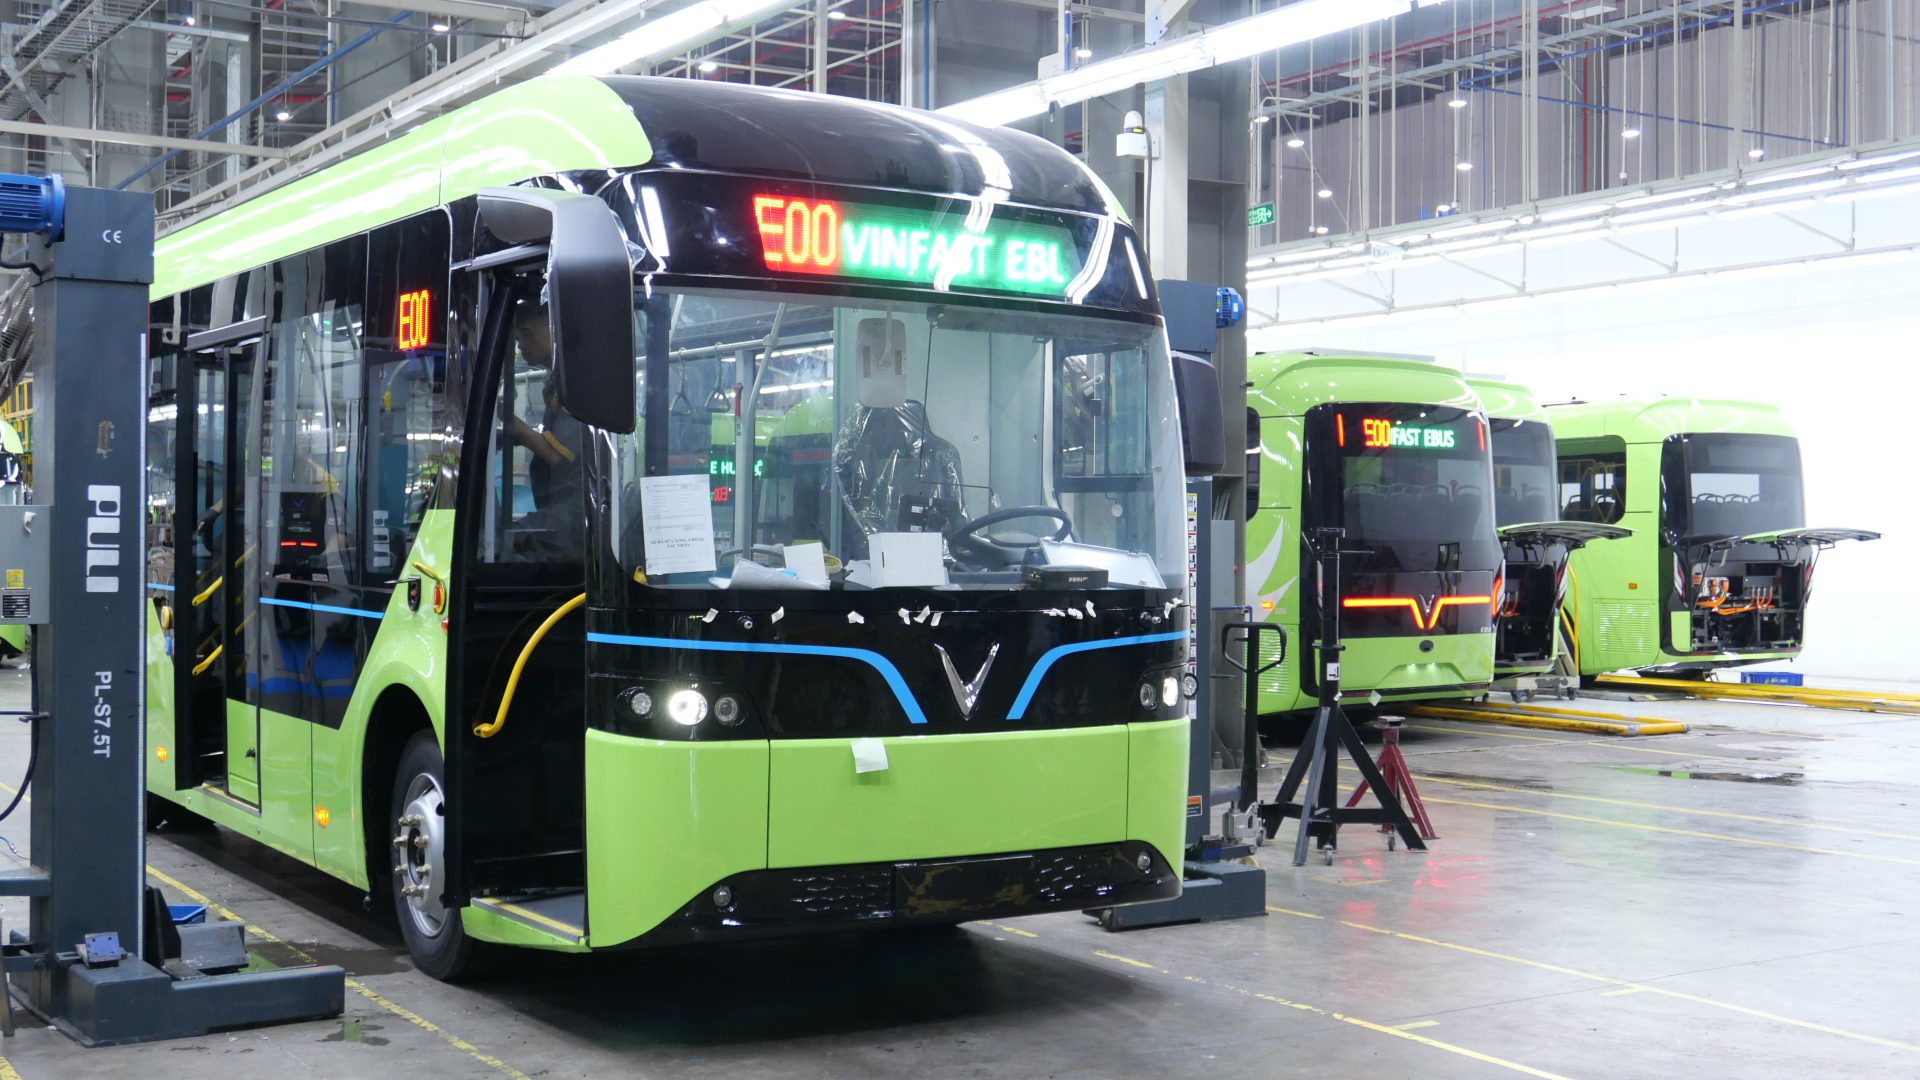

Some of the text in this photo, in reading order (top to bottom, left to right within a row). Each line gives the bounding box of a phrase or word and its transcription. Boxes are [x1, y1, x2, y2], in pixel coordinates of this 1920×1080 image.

[102, 229, 123, 244] CE
[399, 289, 429, 350] E00
[1423, 428, 1456, 448] EBUS
[92, 670, 113, 759] PL-S7.5T
